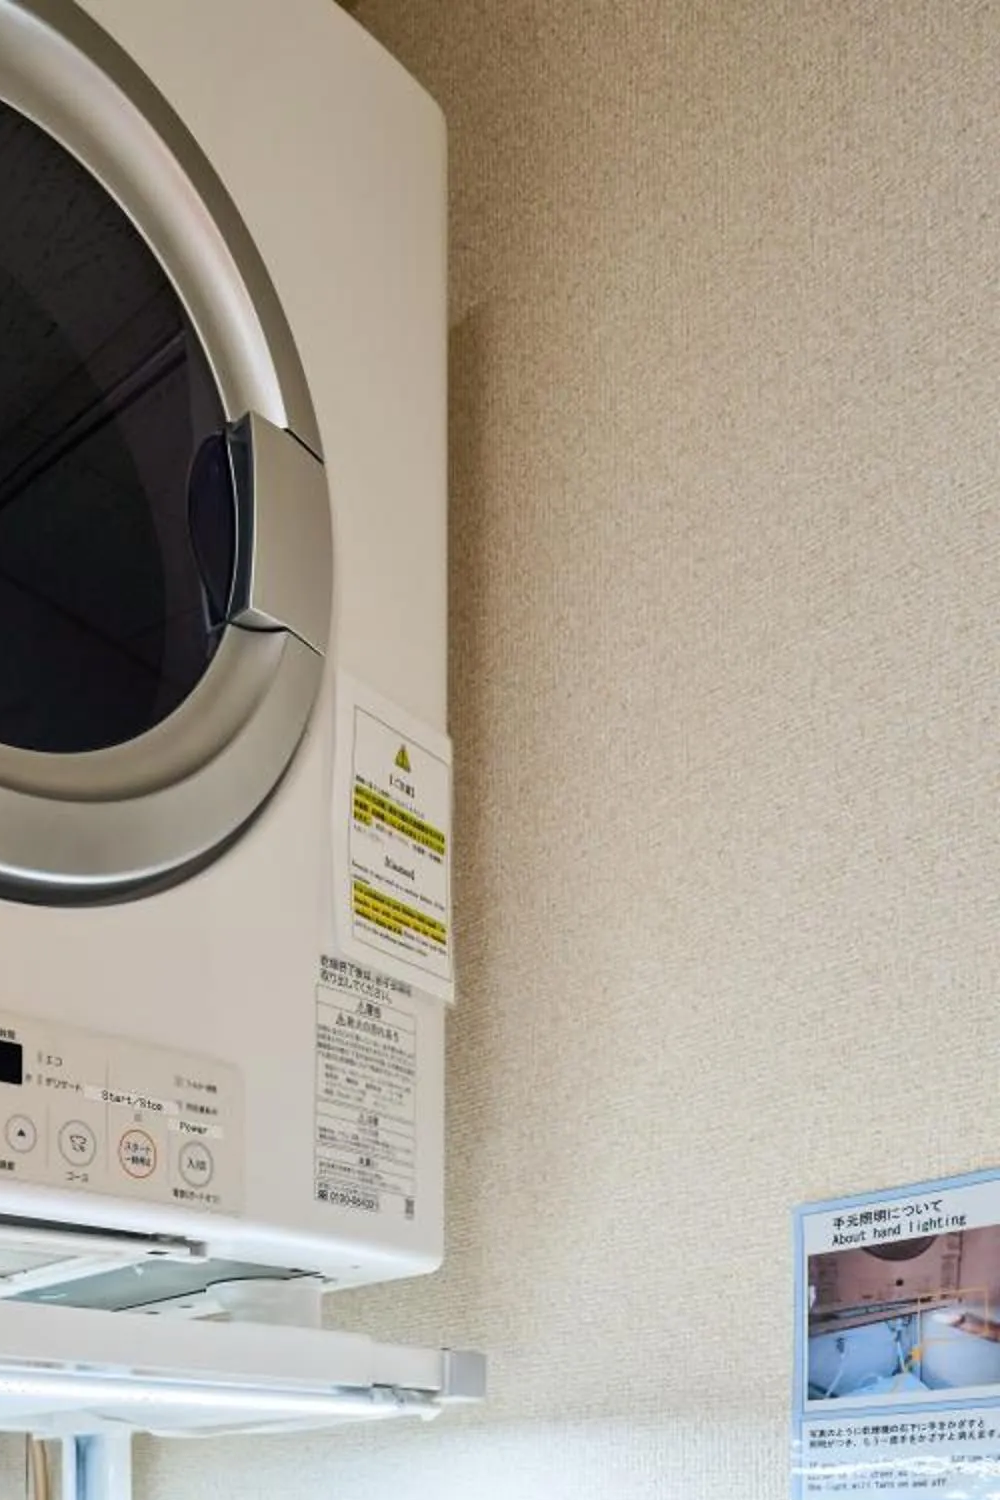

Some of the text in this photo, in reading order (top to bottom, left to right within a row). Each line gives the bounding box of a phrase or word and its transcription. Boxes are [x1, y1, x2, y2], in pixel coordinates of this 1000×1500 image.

[179, 1121, 208, 1136] Power
[832, 1200, 944, 1231] 手元照明について
[832, 1213, 967, 1246] About hand lighting
